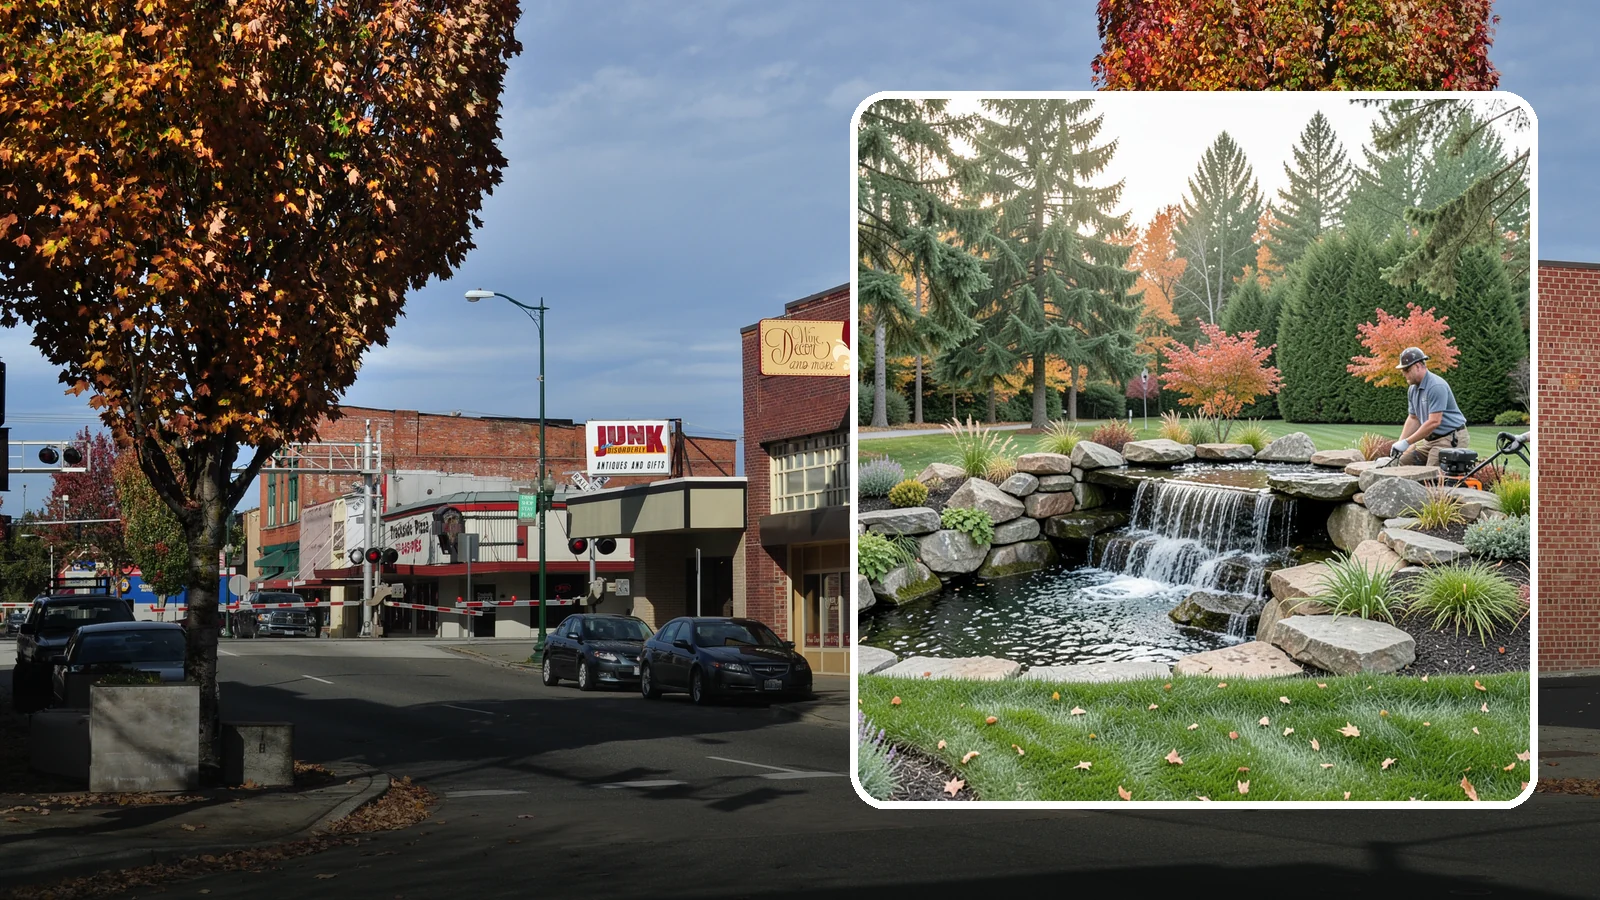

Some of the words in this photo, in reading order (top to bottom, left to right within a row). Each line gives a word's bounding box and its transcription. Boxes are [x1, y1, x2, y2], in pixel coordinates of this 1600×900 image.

[764, 327, 831, 365] Decor
[595, 425, 665, 457] JUNK
[607, 446, 645, 454] DISORDERLY
[596, 461, 628, 470] ANTIQUES
[631, 461, 644, 470] AND
[646, 460, 666, 469] GIFTS
[390, 521, 412, 540] Trackside
[414, 519, 429, 535] Pizza
